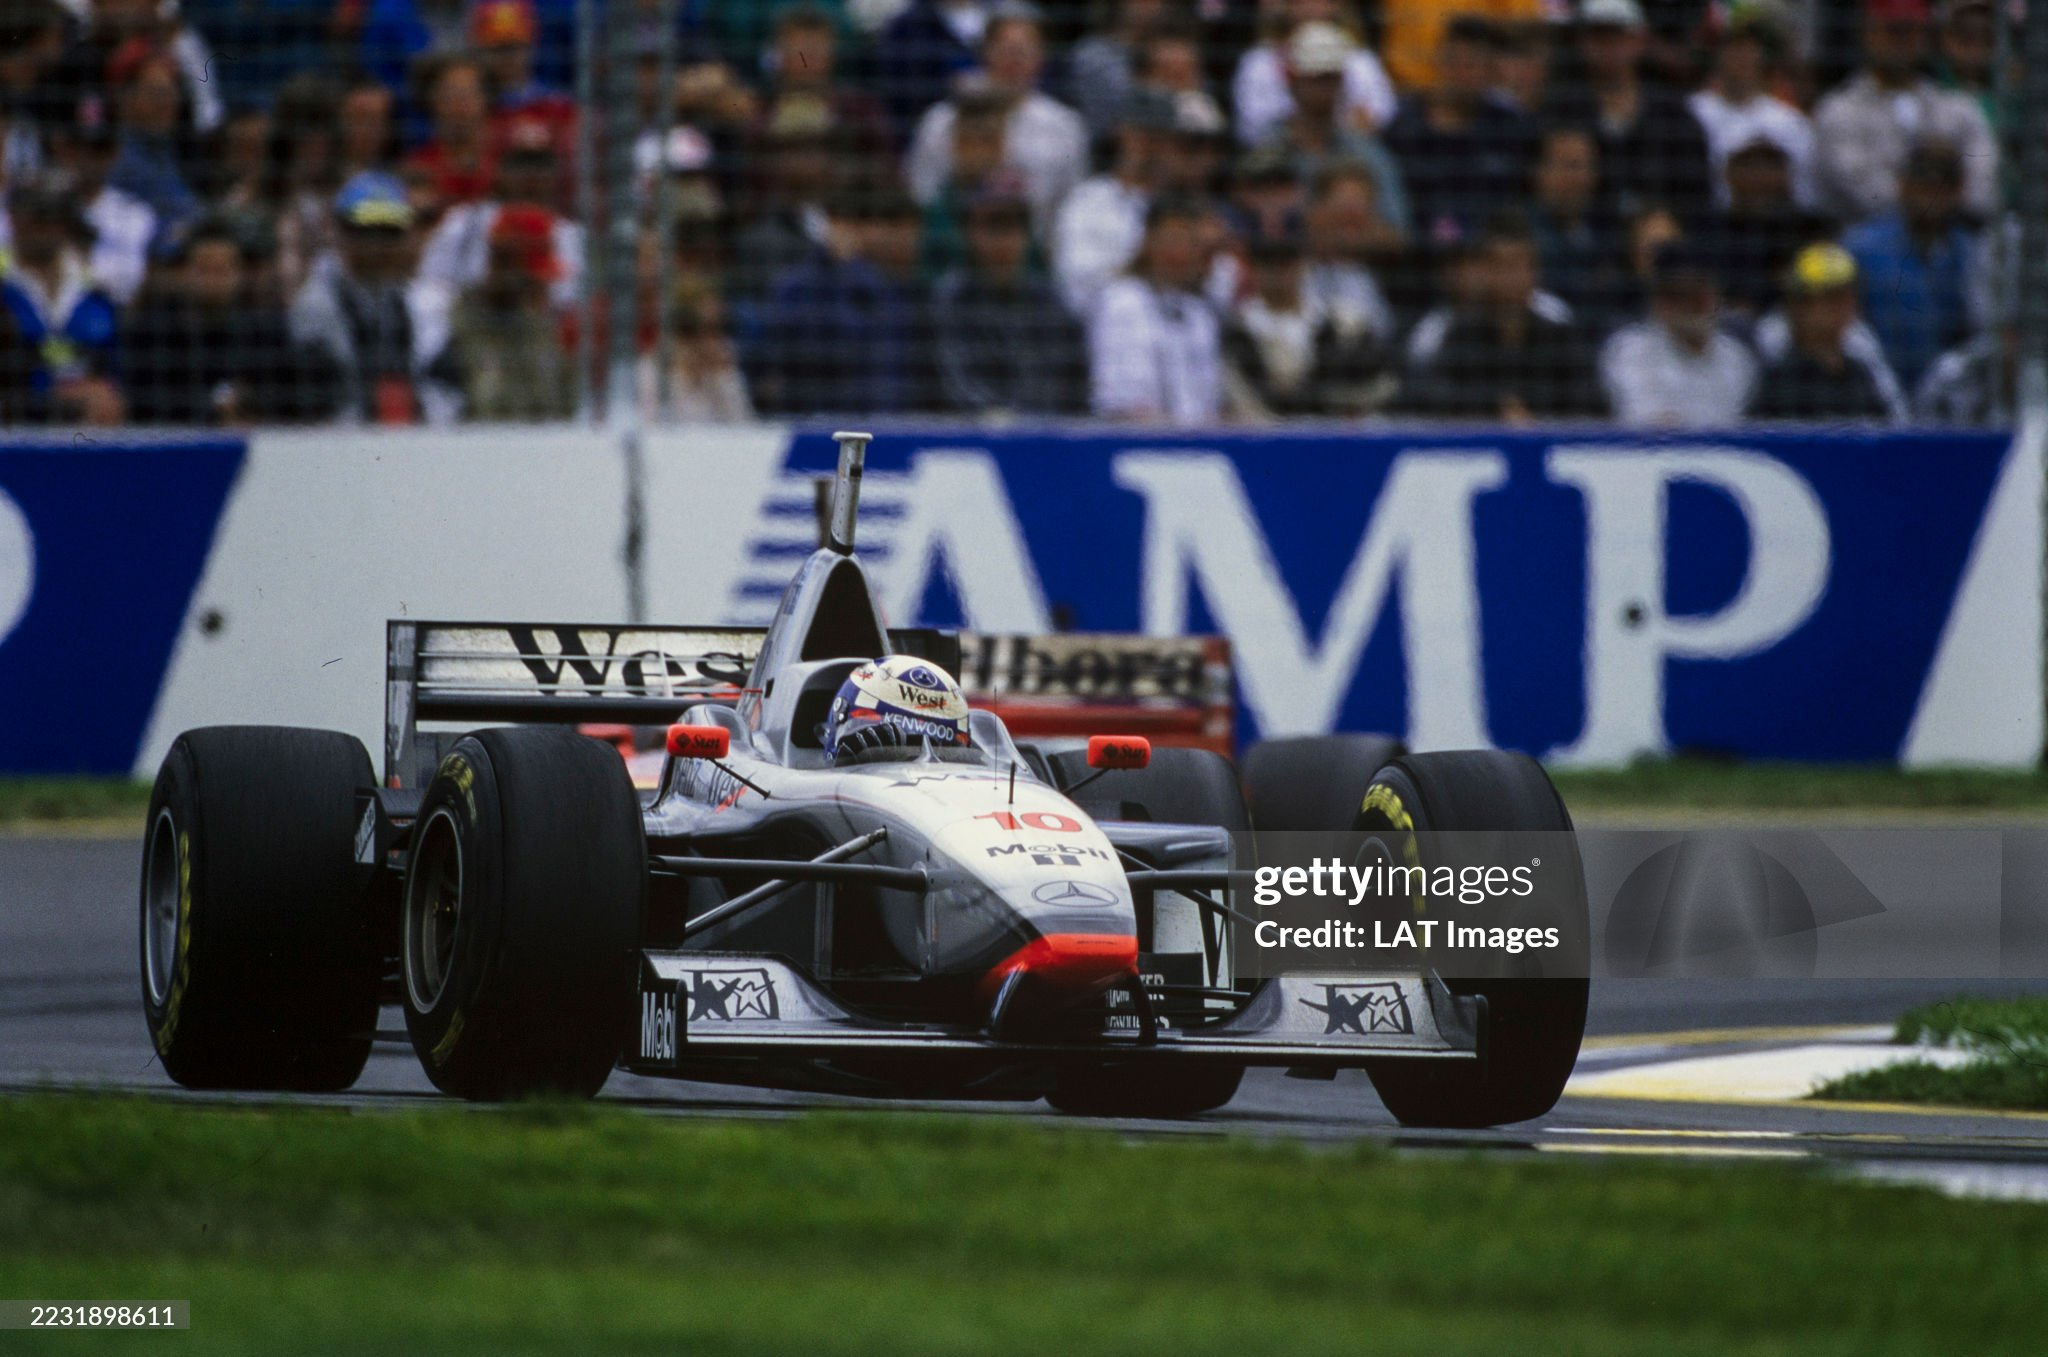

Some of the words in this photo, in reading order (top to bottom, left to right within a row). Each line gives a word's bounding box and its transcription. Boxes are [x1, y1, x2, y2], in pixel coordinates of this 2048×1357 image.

[885, 445, 1832, 770] AMP
[507, 627, 757, 697] Wes
[898, 683, 948, 711] West
[883, 711, 955, 742] KENWOOD
[973, 811, 1083, 833] 10
[985, 842, 1110, 861] Mobil
[641, 991, 677, 1060] Mobi
